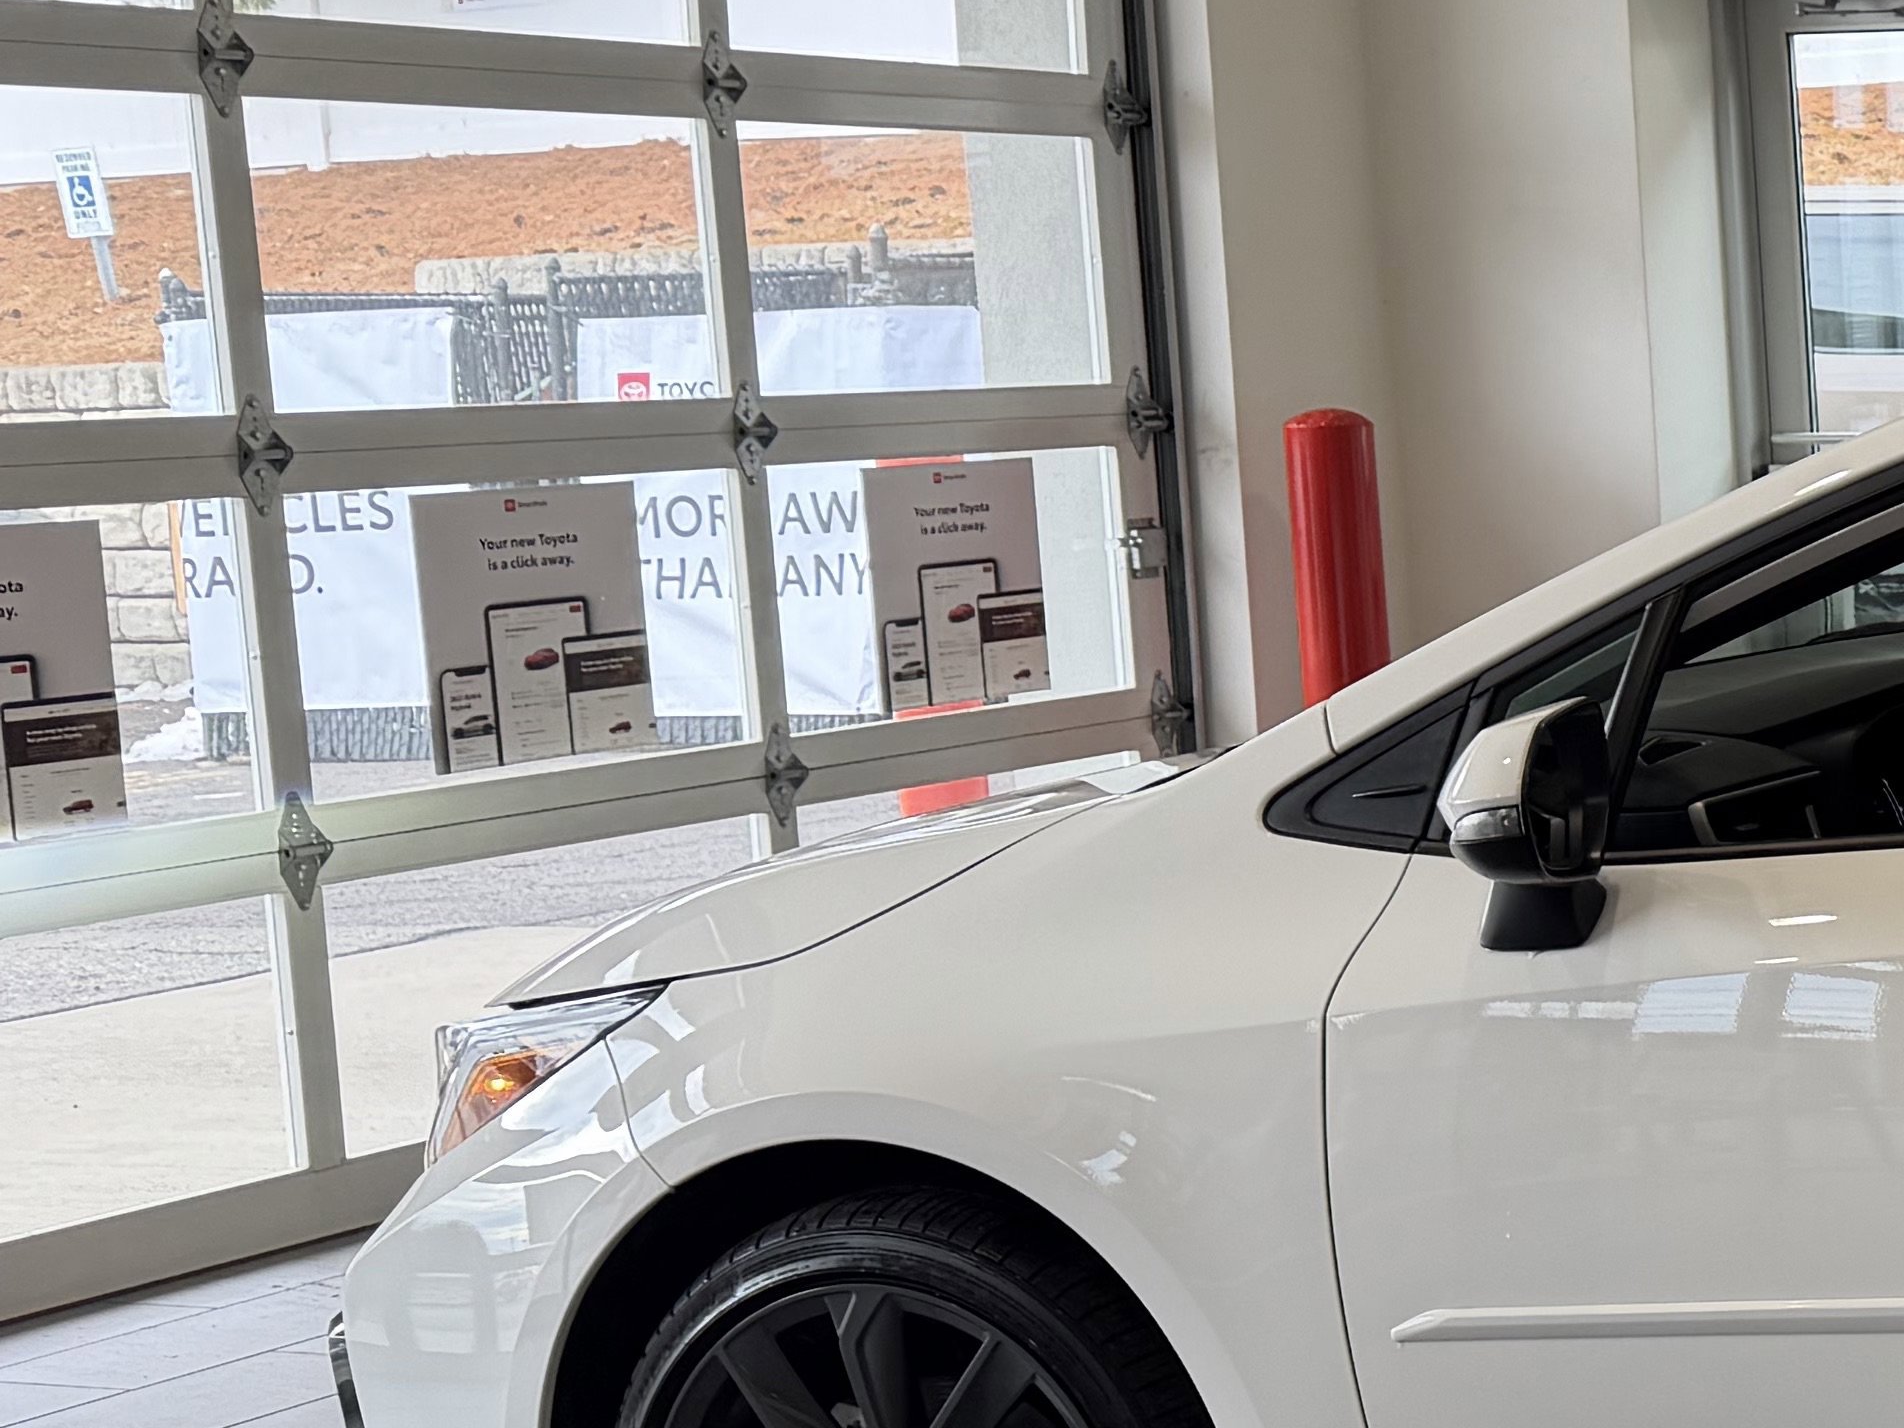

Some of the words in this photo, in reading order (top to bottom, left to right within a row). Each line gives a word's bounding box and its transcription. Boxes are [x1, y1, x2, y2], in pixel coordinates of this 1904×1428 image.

[479, 538, 508, 550] Your
[510, 538, 536, 548] new
[538, 533, 578, 548] Toyota
[487, 558, 498, 570] is
[500, 561, 508, 570] a
[510, 554, 538, 569] click
[541, 555, 575, 568] away.
